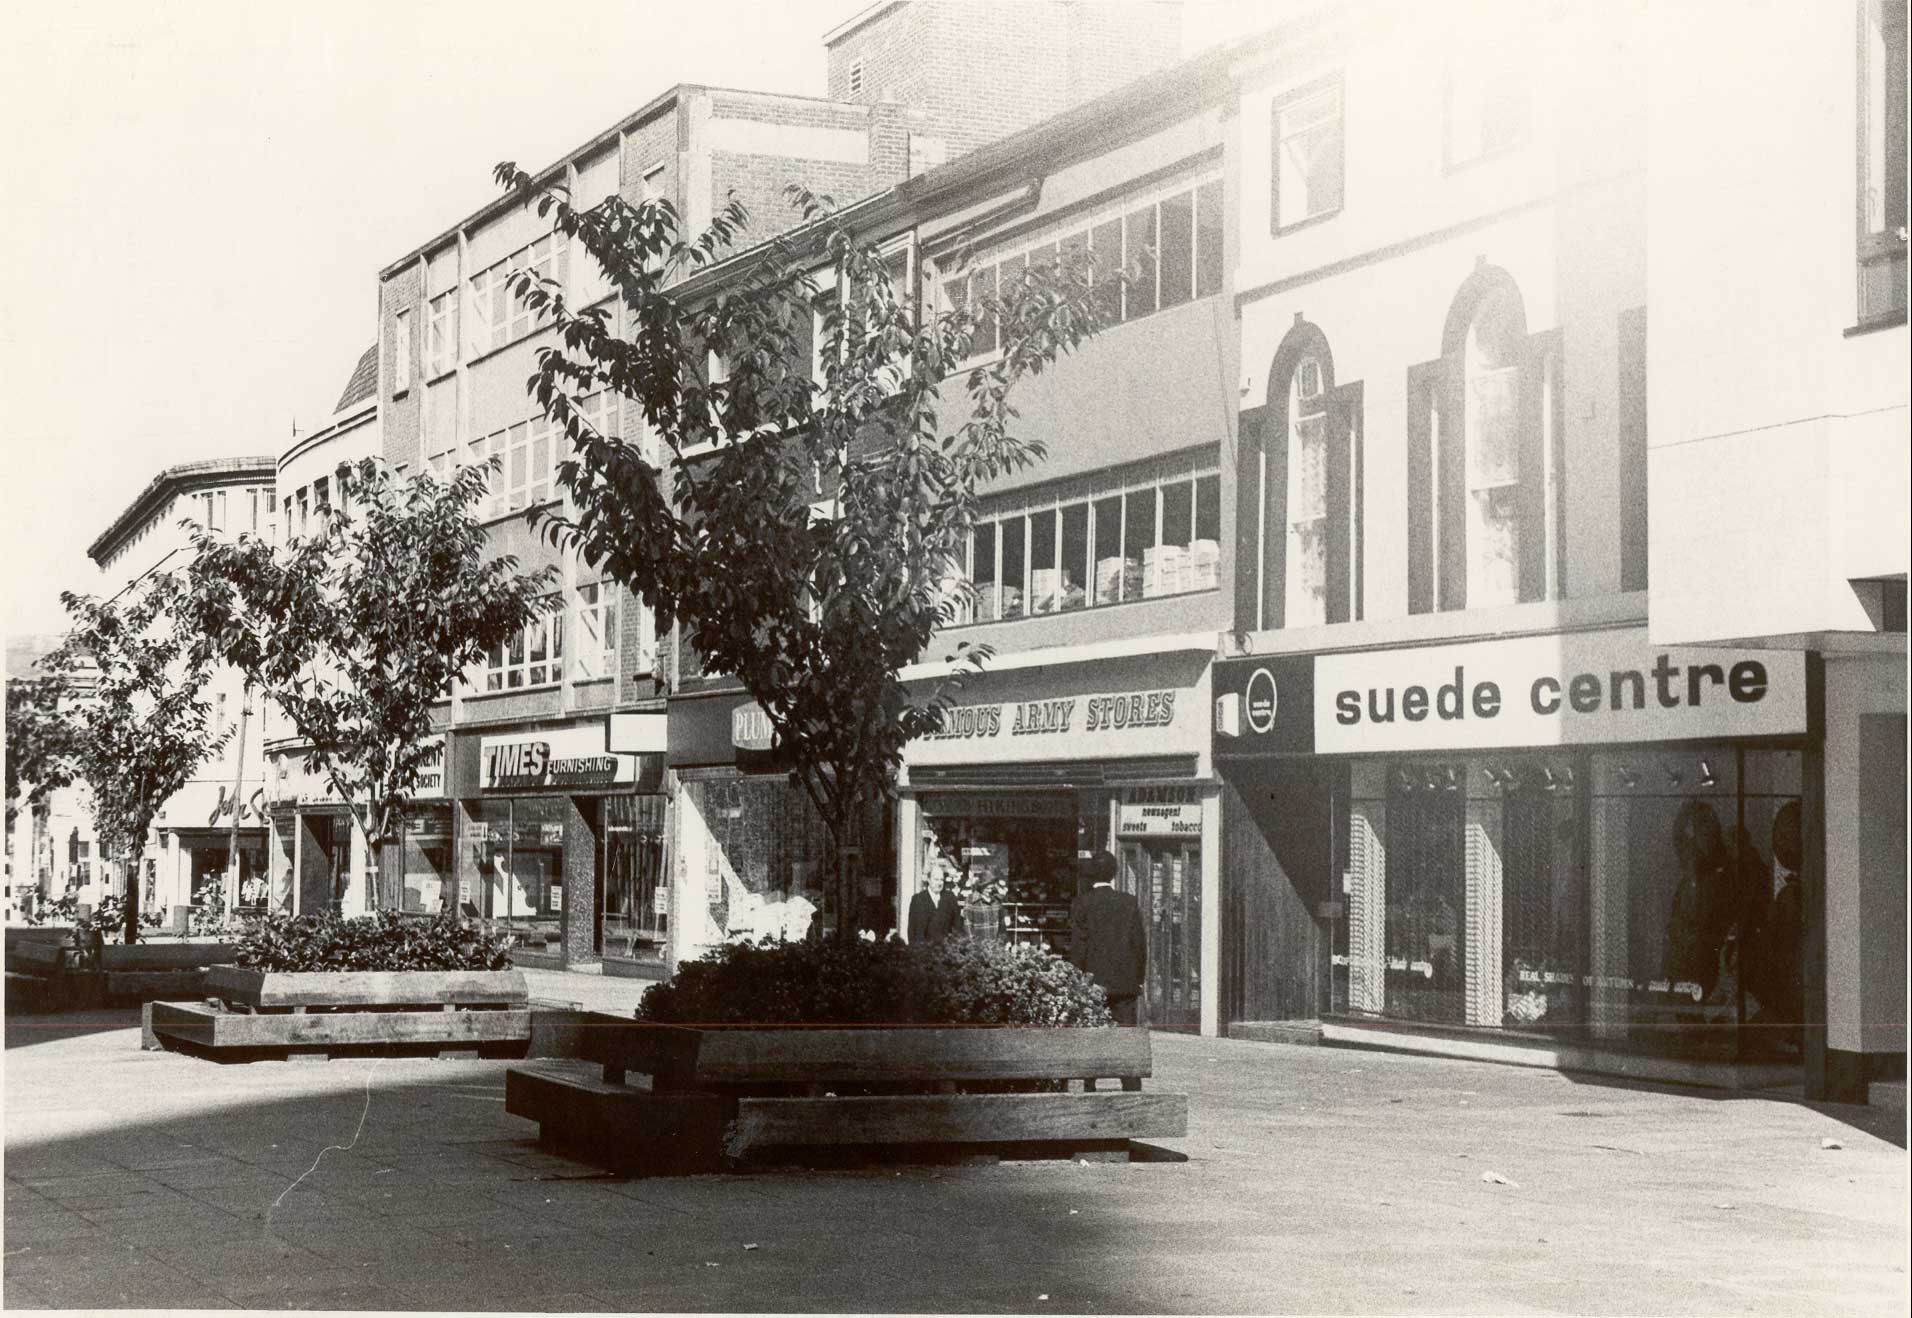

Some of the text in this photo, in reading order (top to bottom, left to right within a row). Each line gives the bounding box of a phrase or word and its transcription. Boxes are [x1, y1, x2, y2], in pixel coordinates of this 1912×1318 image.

[1336, 653, 1768, 726] suede centre
[922, 706, 1002, 742] MOUS
[1011, 699, 1075, 735] ARMY
[1086, 690, 1176, 731] STORES
[483, 741, 611, 778] TIMES FURNISHING
[1122, 820, 1202, 832] sweets tobacco
[1142, 806, 1181, 820] newsagent
